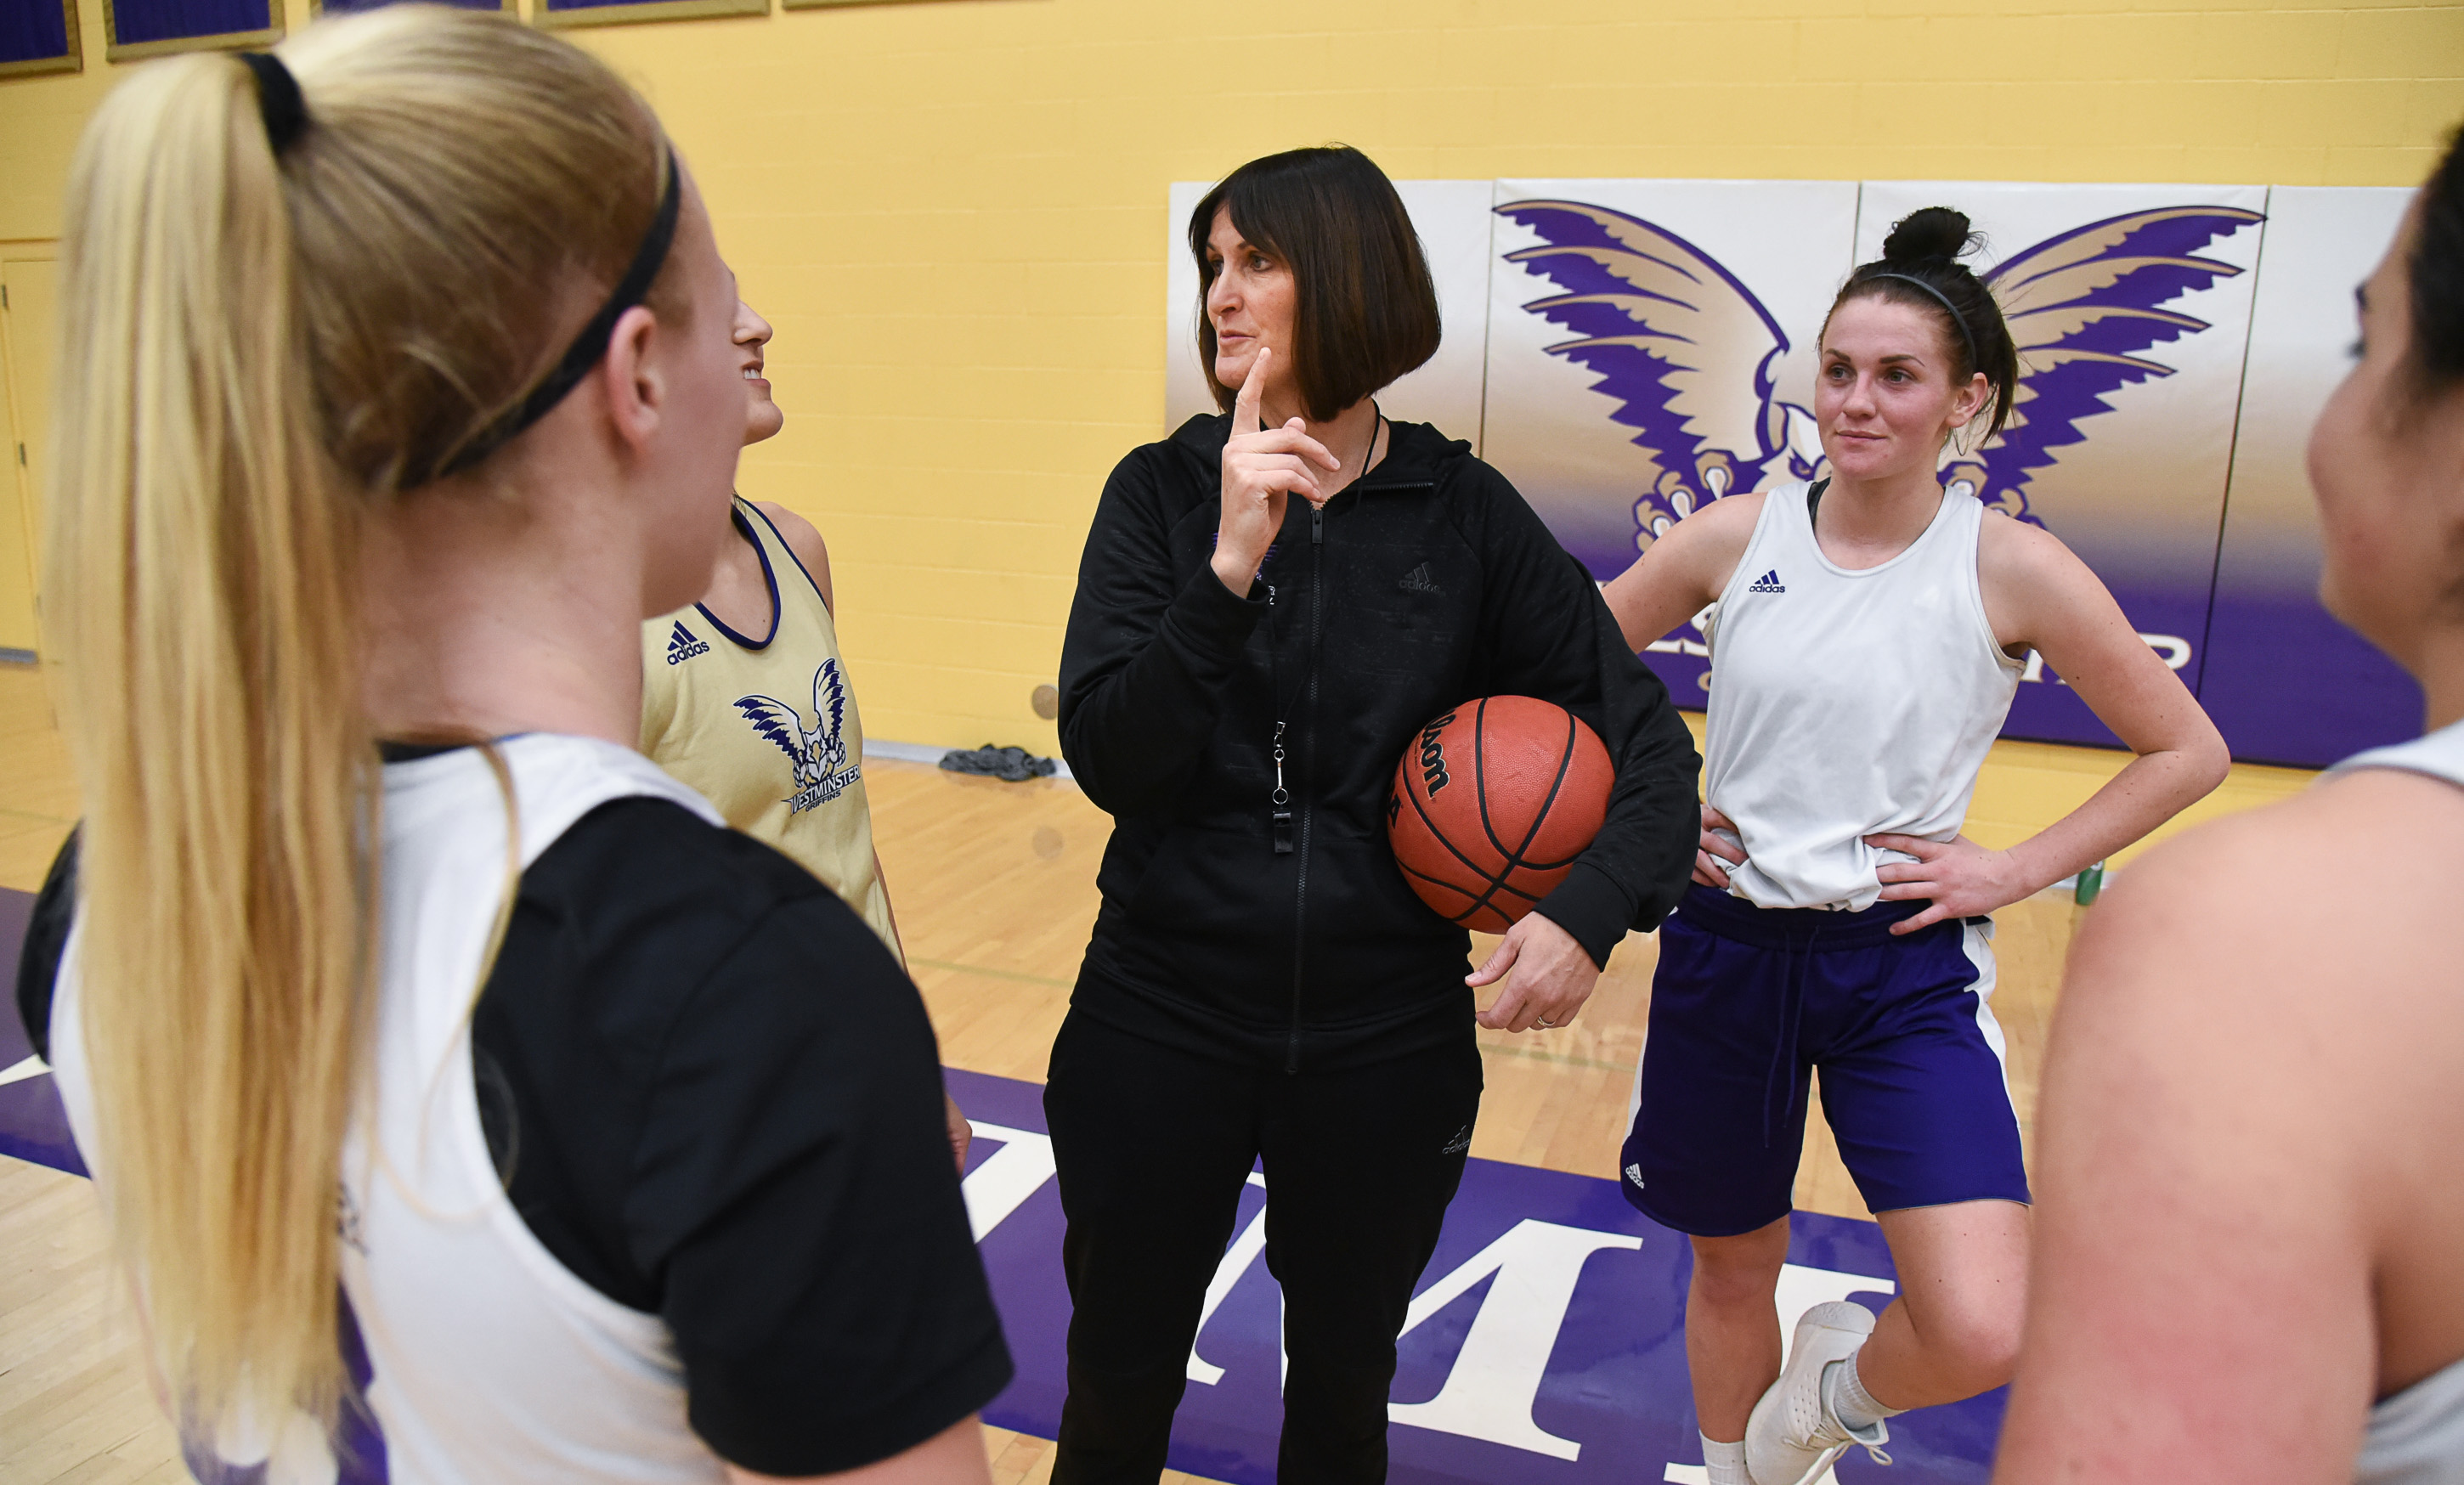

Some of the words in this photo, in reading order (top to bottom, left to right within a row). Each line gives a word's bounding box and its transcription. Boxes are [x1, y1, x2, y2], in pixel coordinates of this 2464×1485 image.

[1749, 584, 1786, 593] adidas
[667, 641, 710, 666] adidas
[782, 764, 861, 816] WESTMINSTER
[805, 789, 841, 812] GRIFFINS
